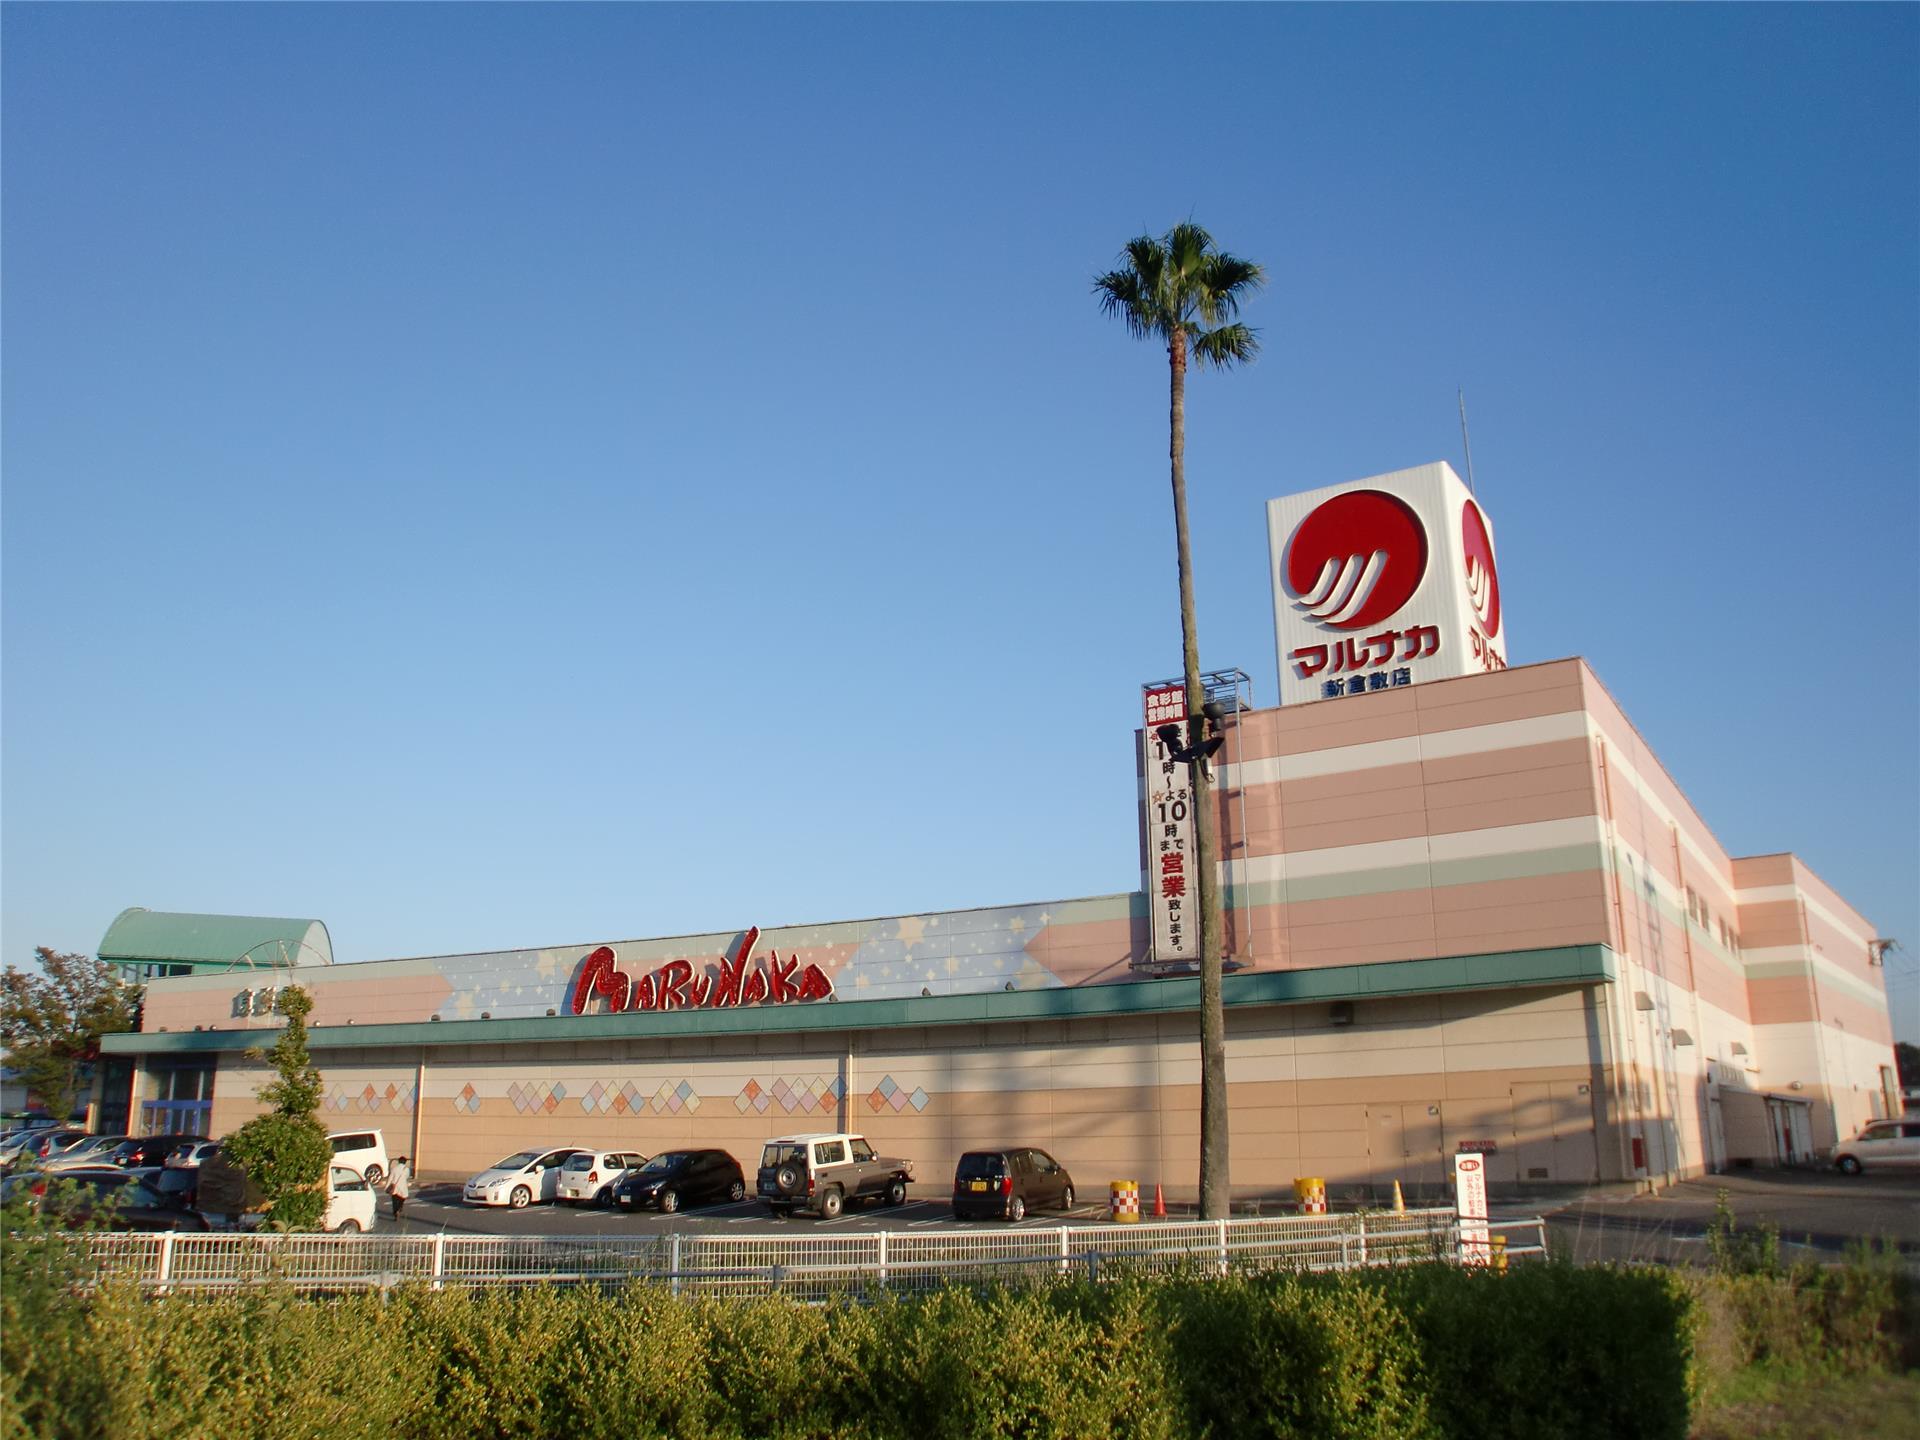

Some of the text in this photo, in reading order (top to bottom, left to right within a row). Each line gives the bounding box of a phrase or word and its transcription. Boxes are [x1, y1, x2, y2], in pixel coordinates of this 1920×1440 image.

[1293, 624, 1441, 678] マルナカ
[1323, 667, 1411, 698] 新倉敷店
[1165, 789, 1188, 802] よる
[1158, 800, 1187, 823] 10
